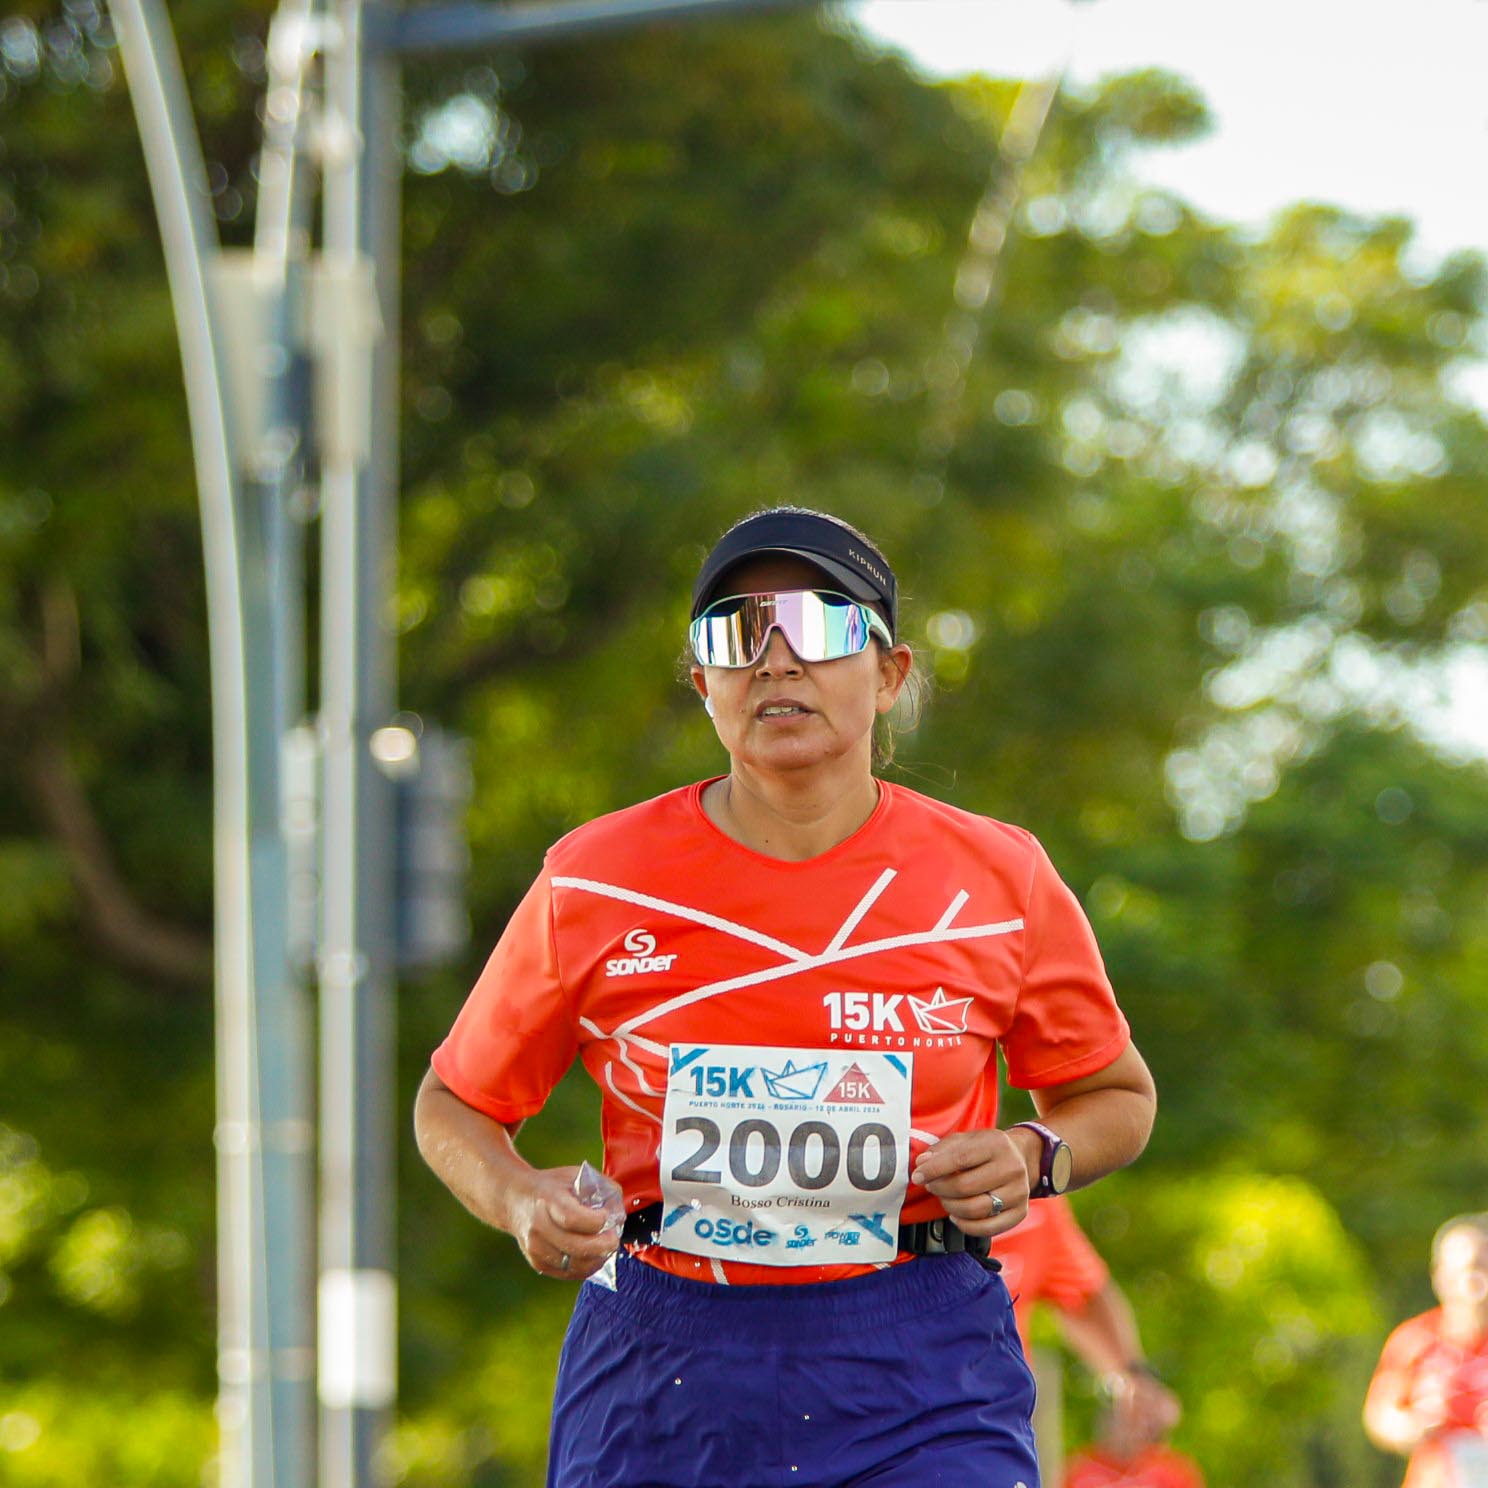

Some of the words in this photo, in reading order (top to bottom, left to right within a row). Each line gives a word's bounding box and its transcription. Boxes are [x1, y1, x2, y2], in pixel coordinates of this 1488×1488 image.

[848, 548, 886, 586] KIPRUN
[823, 991, 905, 1032] 15K
[830, 1032, 905, 1046] PUERTO
[913, 1036, 962, 1047] NORTE
[690, 1065, 756, 1098] 15K
[839, 1081, 871, 1099] 15K
[689, 1100, 718, 1108] PUERTO
[721, 1101, 744, 1109] NORTE
[774, 1103, 807, 1111] ROSARIO
[839, 1105, 860, 1113] ABRIL
[671, 1116, 897, 1191] 2000
[731, 1195, 772, 1209] Bosso
[776, 1196, 831, 1208] Cristina
